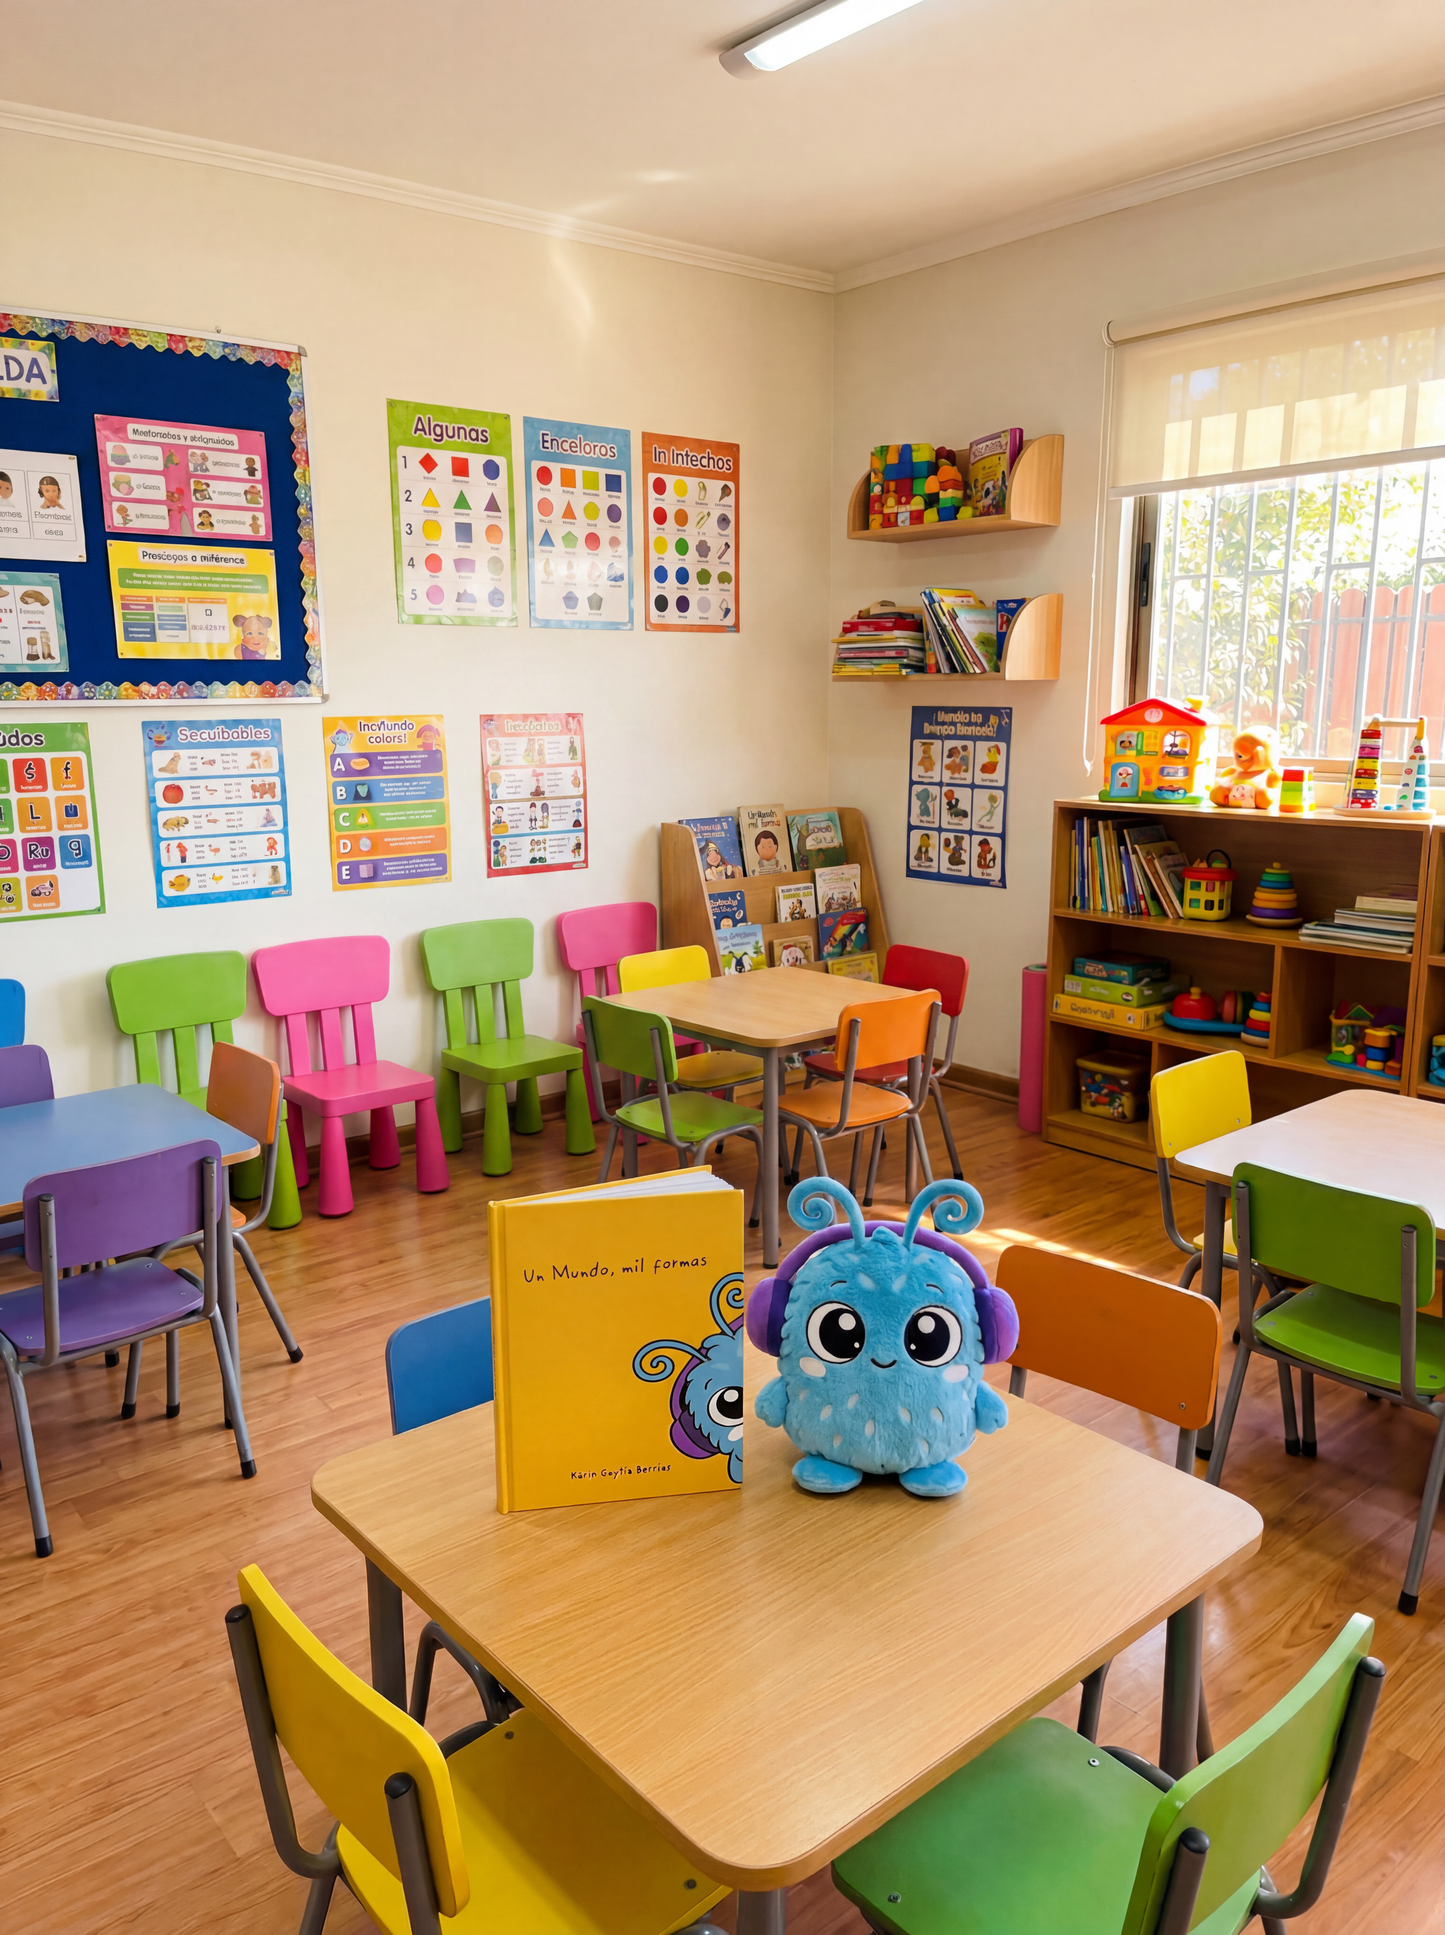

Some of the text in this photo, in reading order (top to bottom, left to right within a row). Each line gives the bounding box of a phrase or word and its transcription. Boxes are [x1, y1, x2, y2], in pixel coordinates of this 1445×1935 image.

[413, 416, 489, 443] Algunas
[541, 433, 617, 458] Enceloros
[402, 456, 408, 469] 1
[653, 446, 732, 471] In Intechos
[404, 490, 412, 502] 2
[405, 523, 413, 535] 3
[407, 557, 415, 569] 4
[410, 589, 417, 600] 5
[178, 726, 270, 741] Secuibables
[333, 757, 346, 772] A
[336, 786, 347, 800] B
[29, 804, 41, 820] L
[339, 812, 351, 827] C
[339, 839, 352, 854] D
[342, 865, 351, 880] E
[523, 1256, 708, 1283] Un Mundo, mil formas
